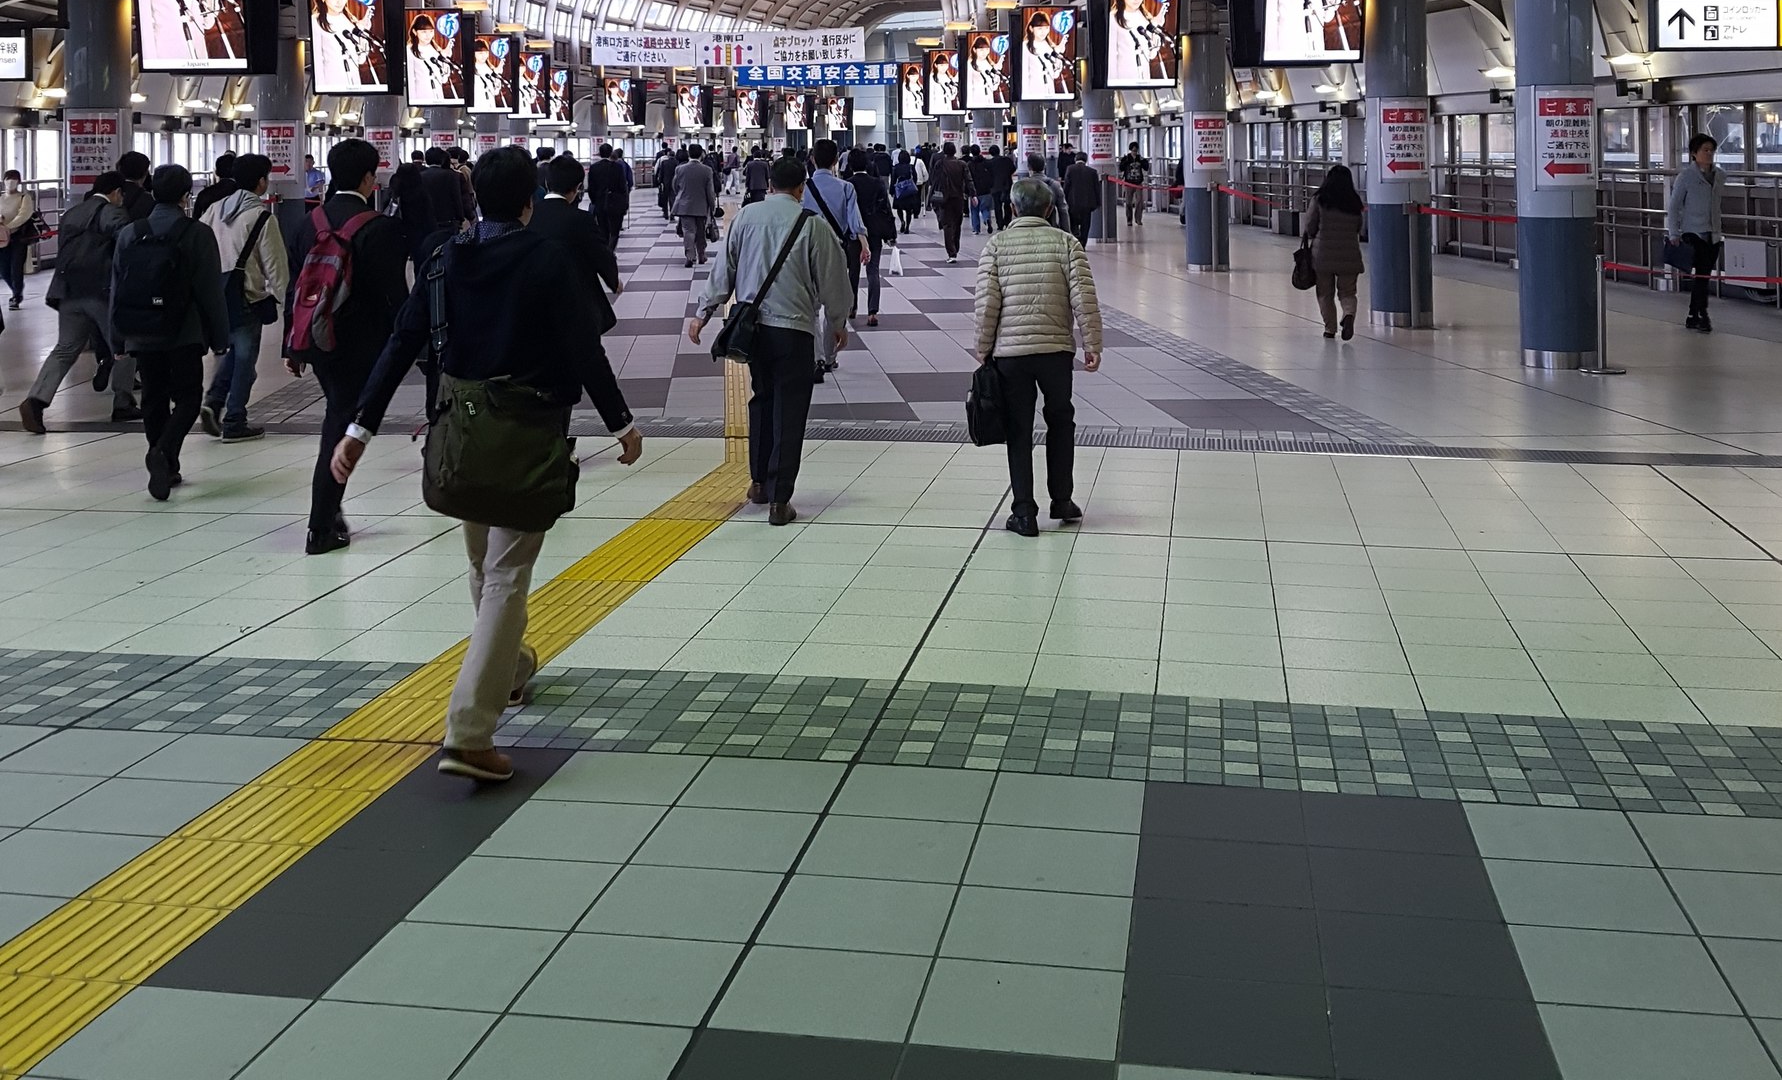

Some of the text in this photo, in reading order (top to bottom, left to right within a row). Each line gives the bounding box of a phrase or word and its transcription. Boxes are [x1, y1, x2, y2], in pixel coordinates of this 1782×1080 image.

[1723, 25, 1747, 33] アトレ
[712, 34, 744, 42] 港南口
[773, 34, 856, 48] 点字ブロック・通行区分に
[616, 51, 667, 63] ご通行ください。
[774, 48, 854, 62] ご協力をお願い致します。
[748, 64, 898, 80] 全国交通安全運動
[1546, 102, 1591, 114] ご案内
